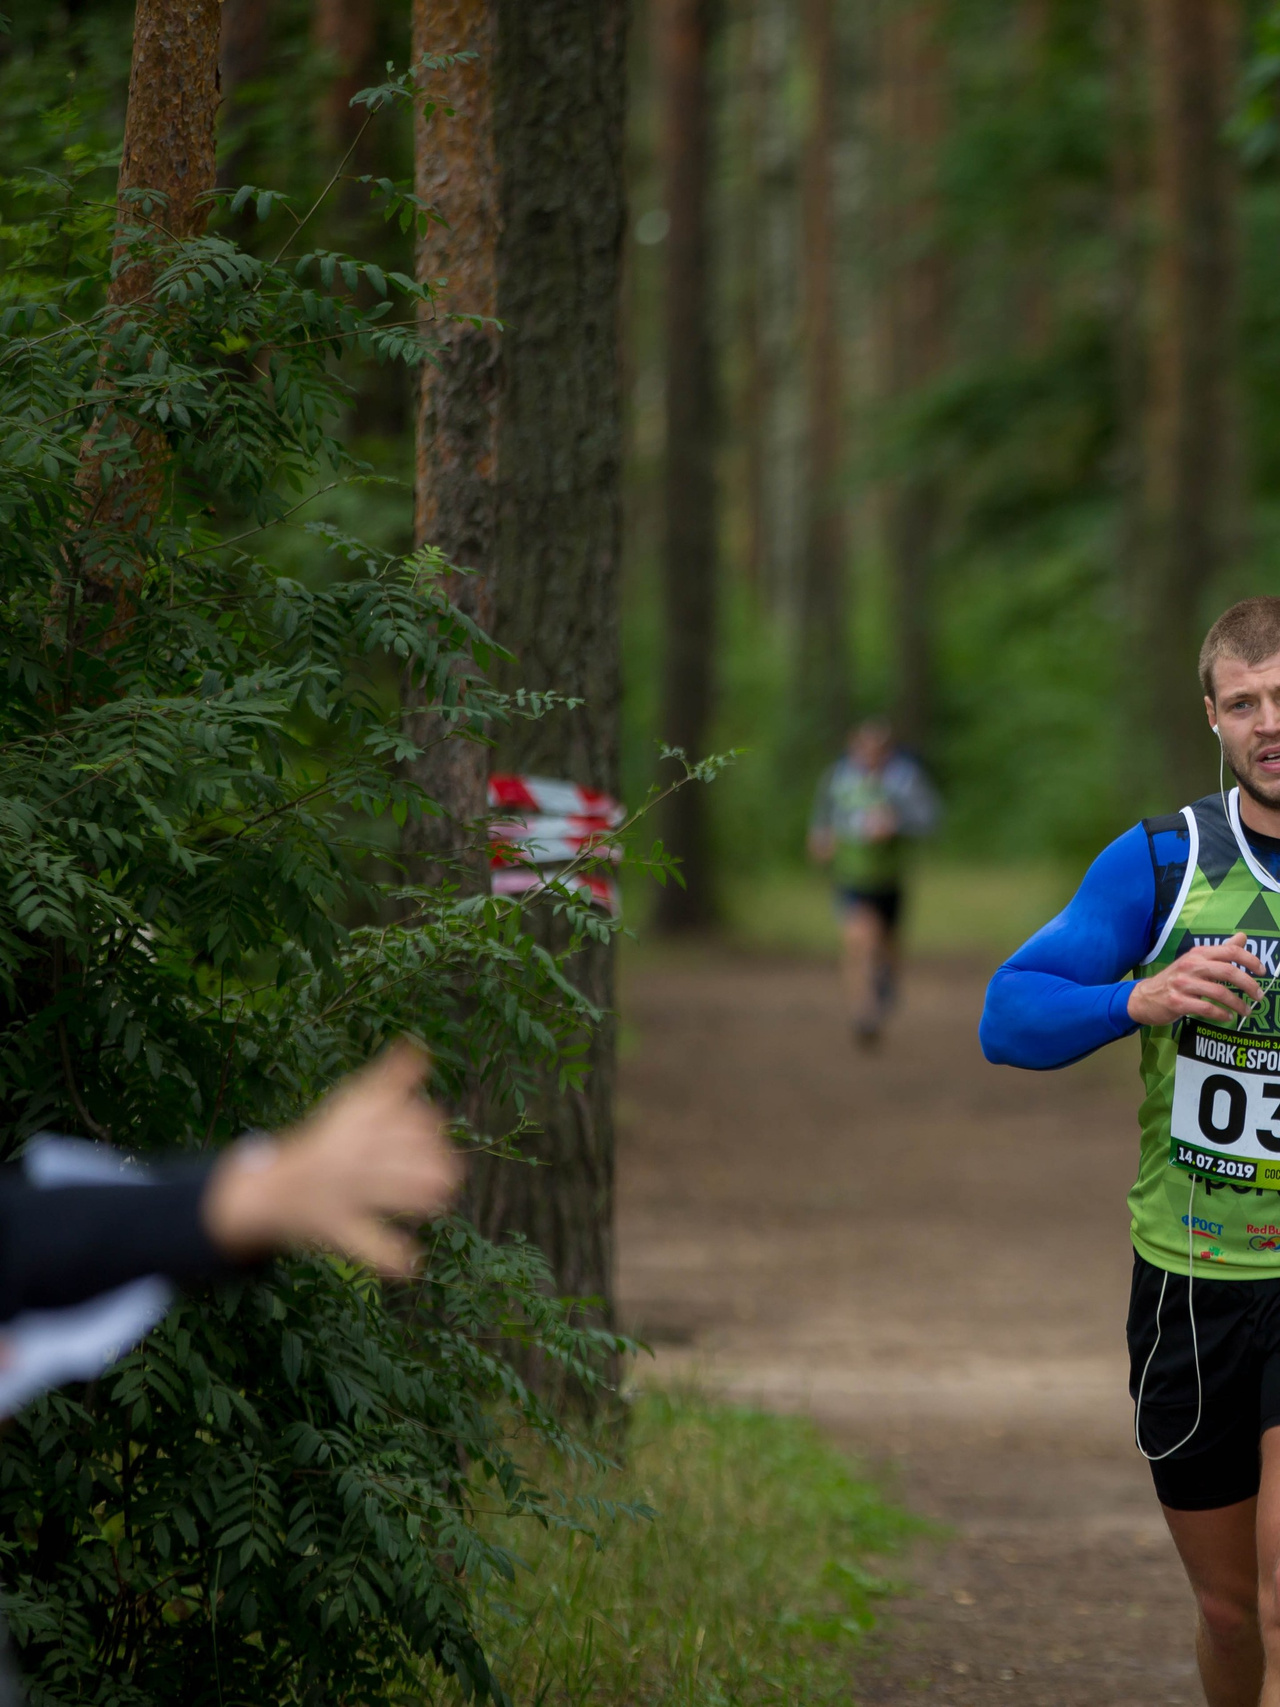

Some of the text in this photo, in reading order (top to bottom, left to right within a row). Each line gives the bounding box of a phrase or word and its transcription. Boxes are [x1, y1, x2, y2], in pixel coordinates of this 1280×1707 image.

[1196, 1026, 1271, 1049] КОРПОРАТИВНЫЙ
[1178, 1147, 1255, 1178] 14.07.2019
[1181, 1214, 1224, 1236] ФРОСТ
[1246, 1224, 1267, 1234] Red
